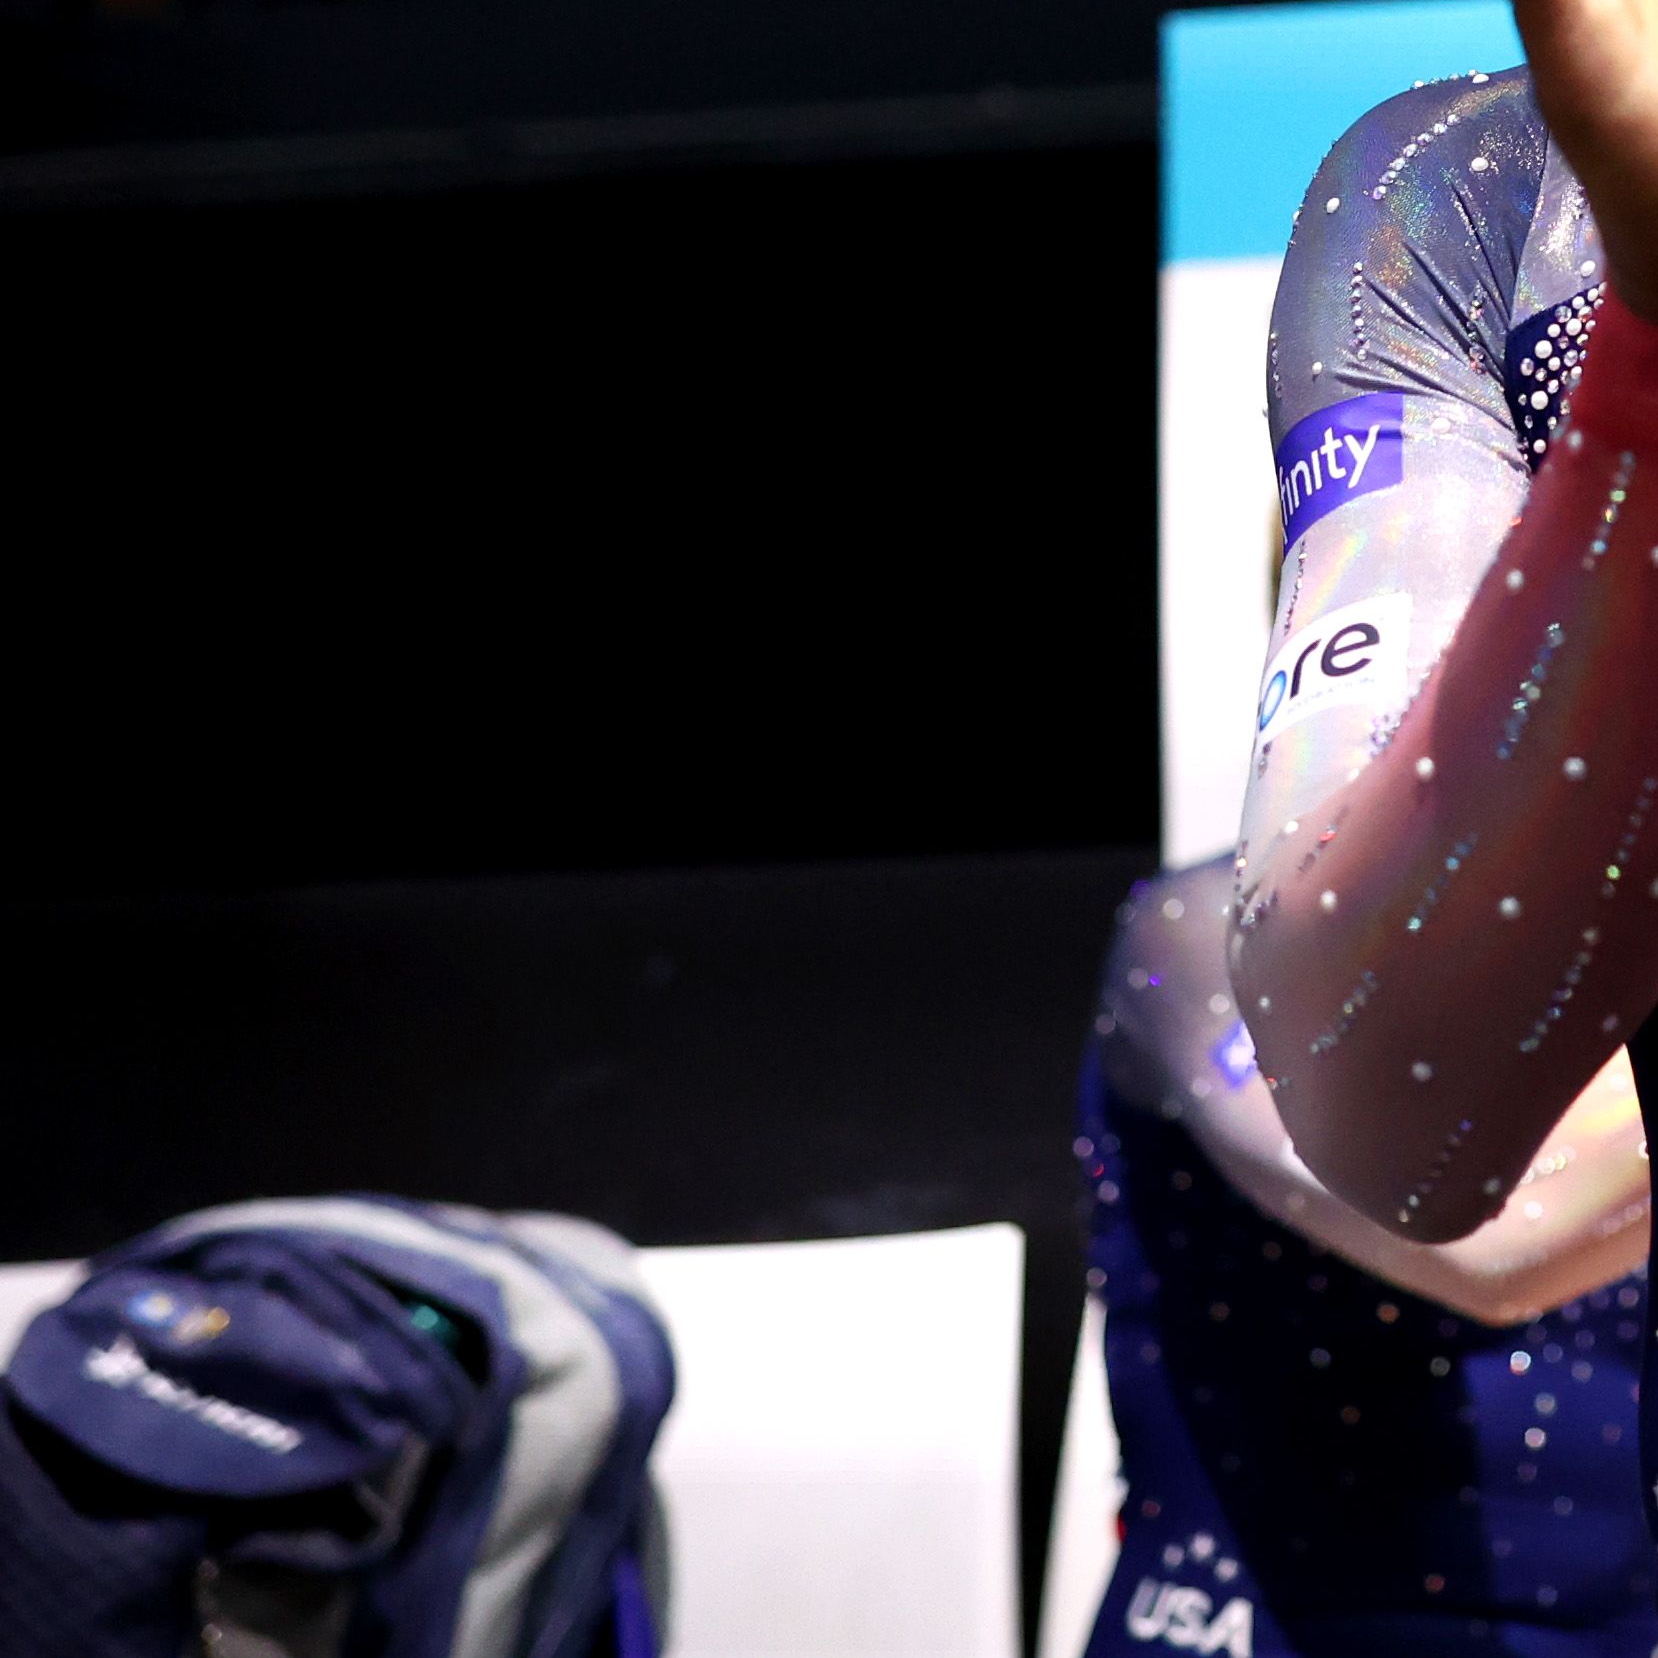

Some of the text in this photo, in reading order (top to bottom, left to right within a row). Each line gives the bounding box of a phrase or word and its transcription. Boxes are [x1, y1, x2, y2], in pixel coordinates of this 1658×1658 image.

[1276, 423, 1381, 544] finity
[1259, 621, 1381, 732] ore
[1126, 1574, 1254, 1658] USA
